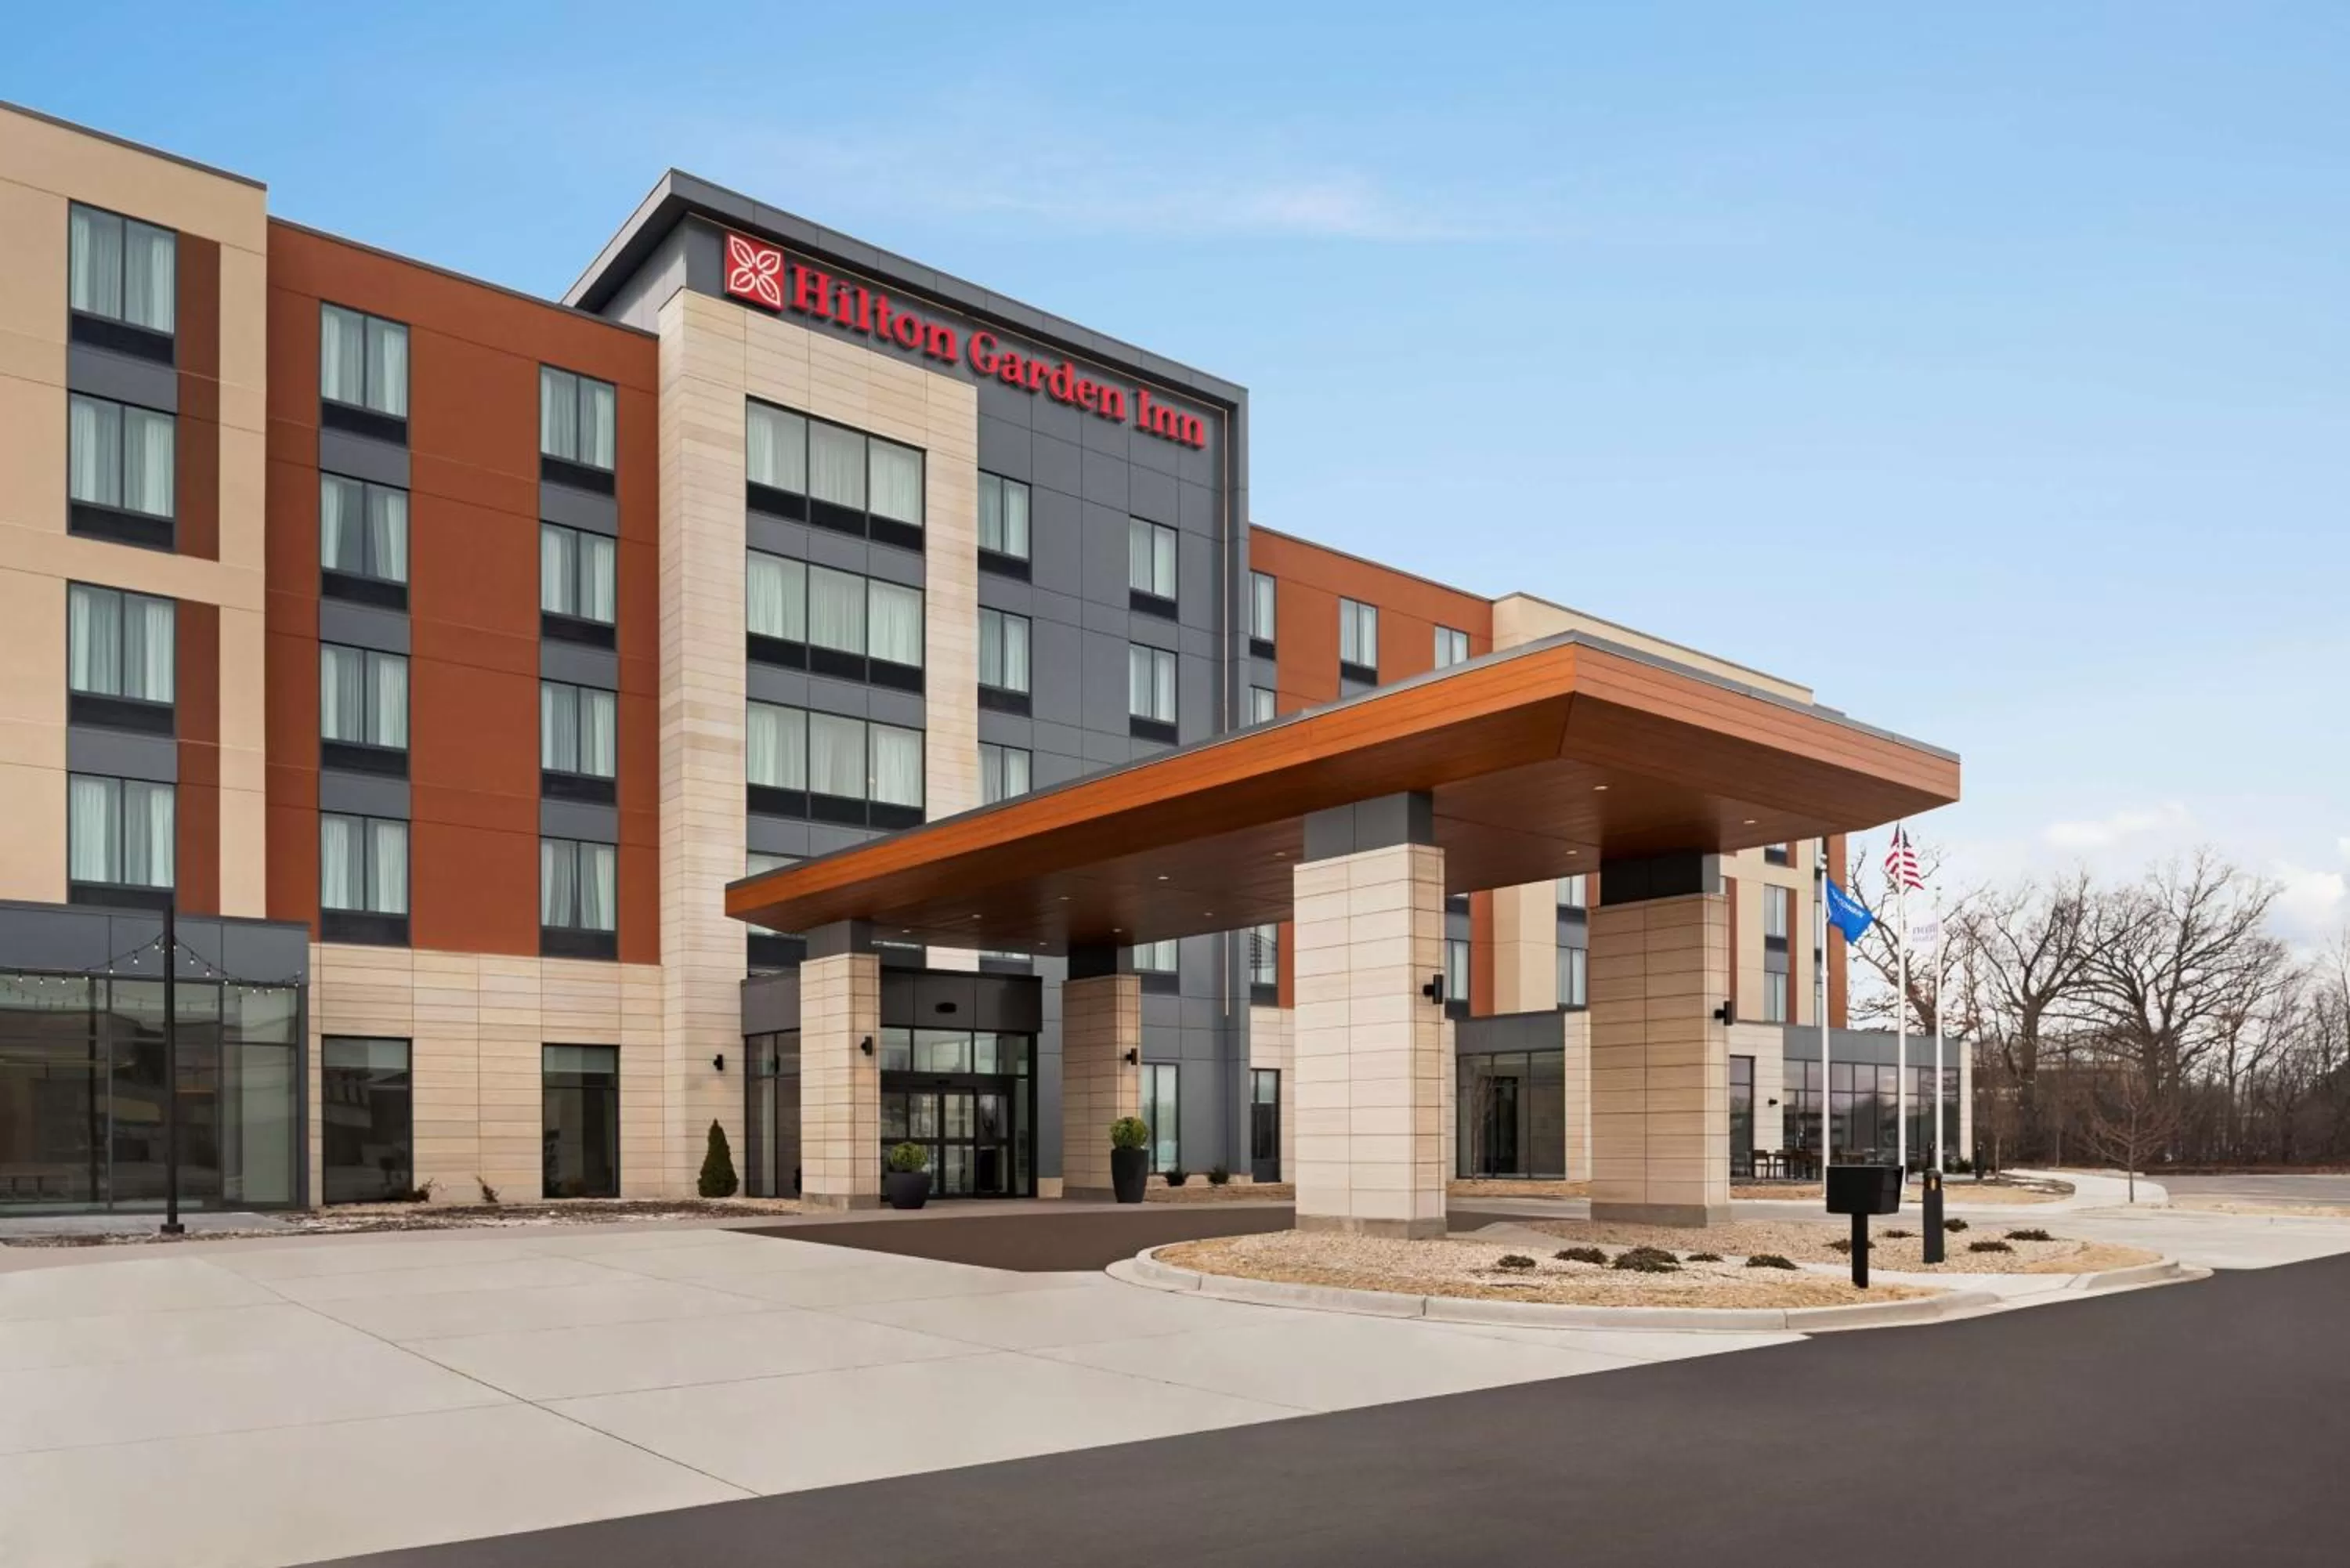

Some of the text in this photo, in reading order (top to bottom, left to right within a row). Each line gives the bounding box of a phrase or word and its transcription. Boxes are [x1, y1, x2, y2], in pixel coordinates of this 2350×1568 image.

[791, 263, 1206, 448] Hilton Garden Inn
